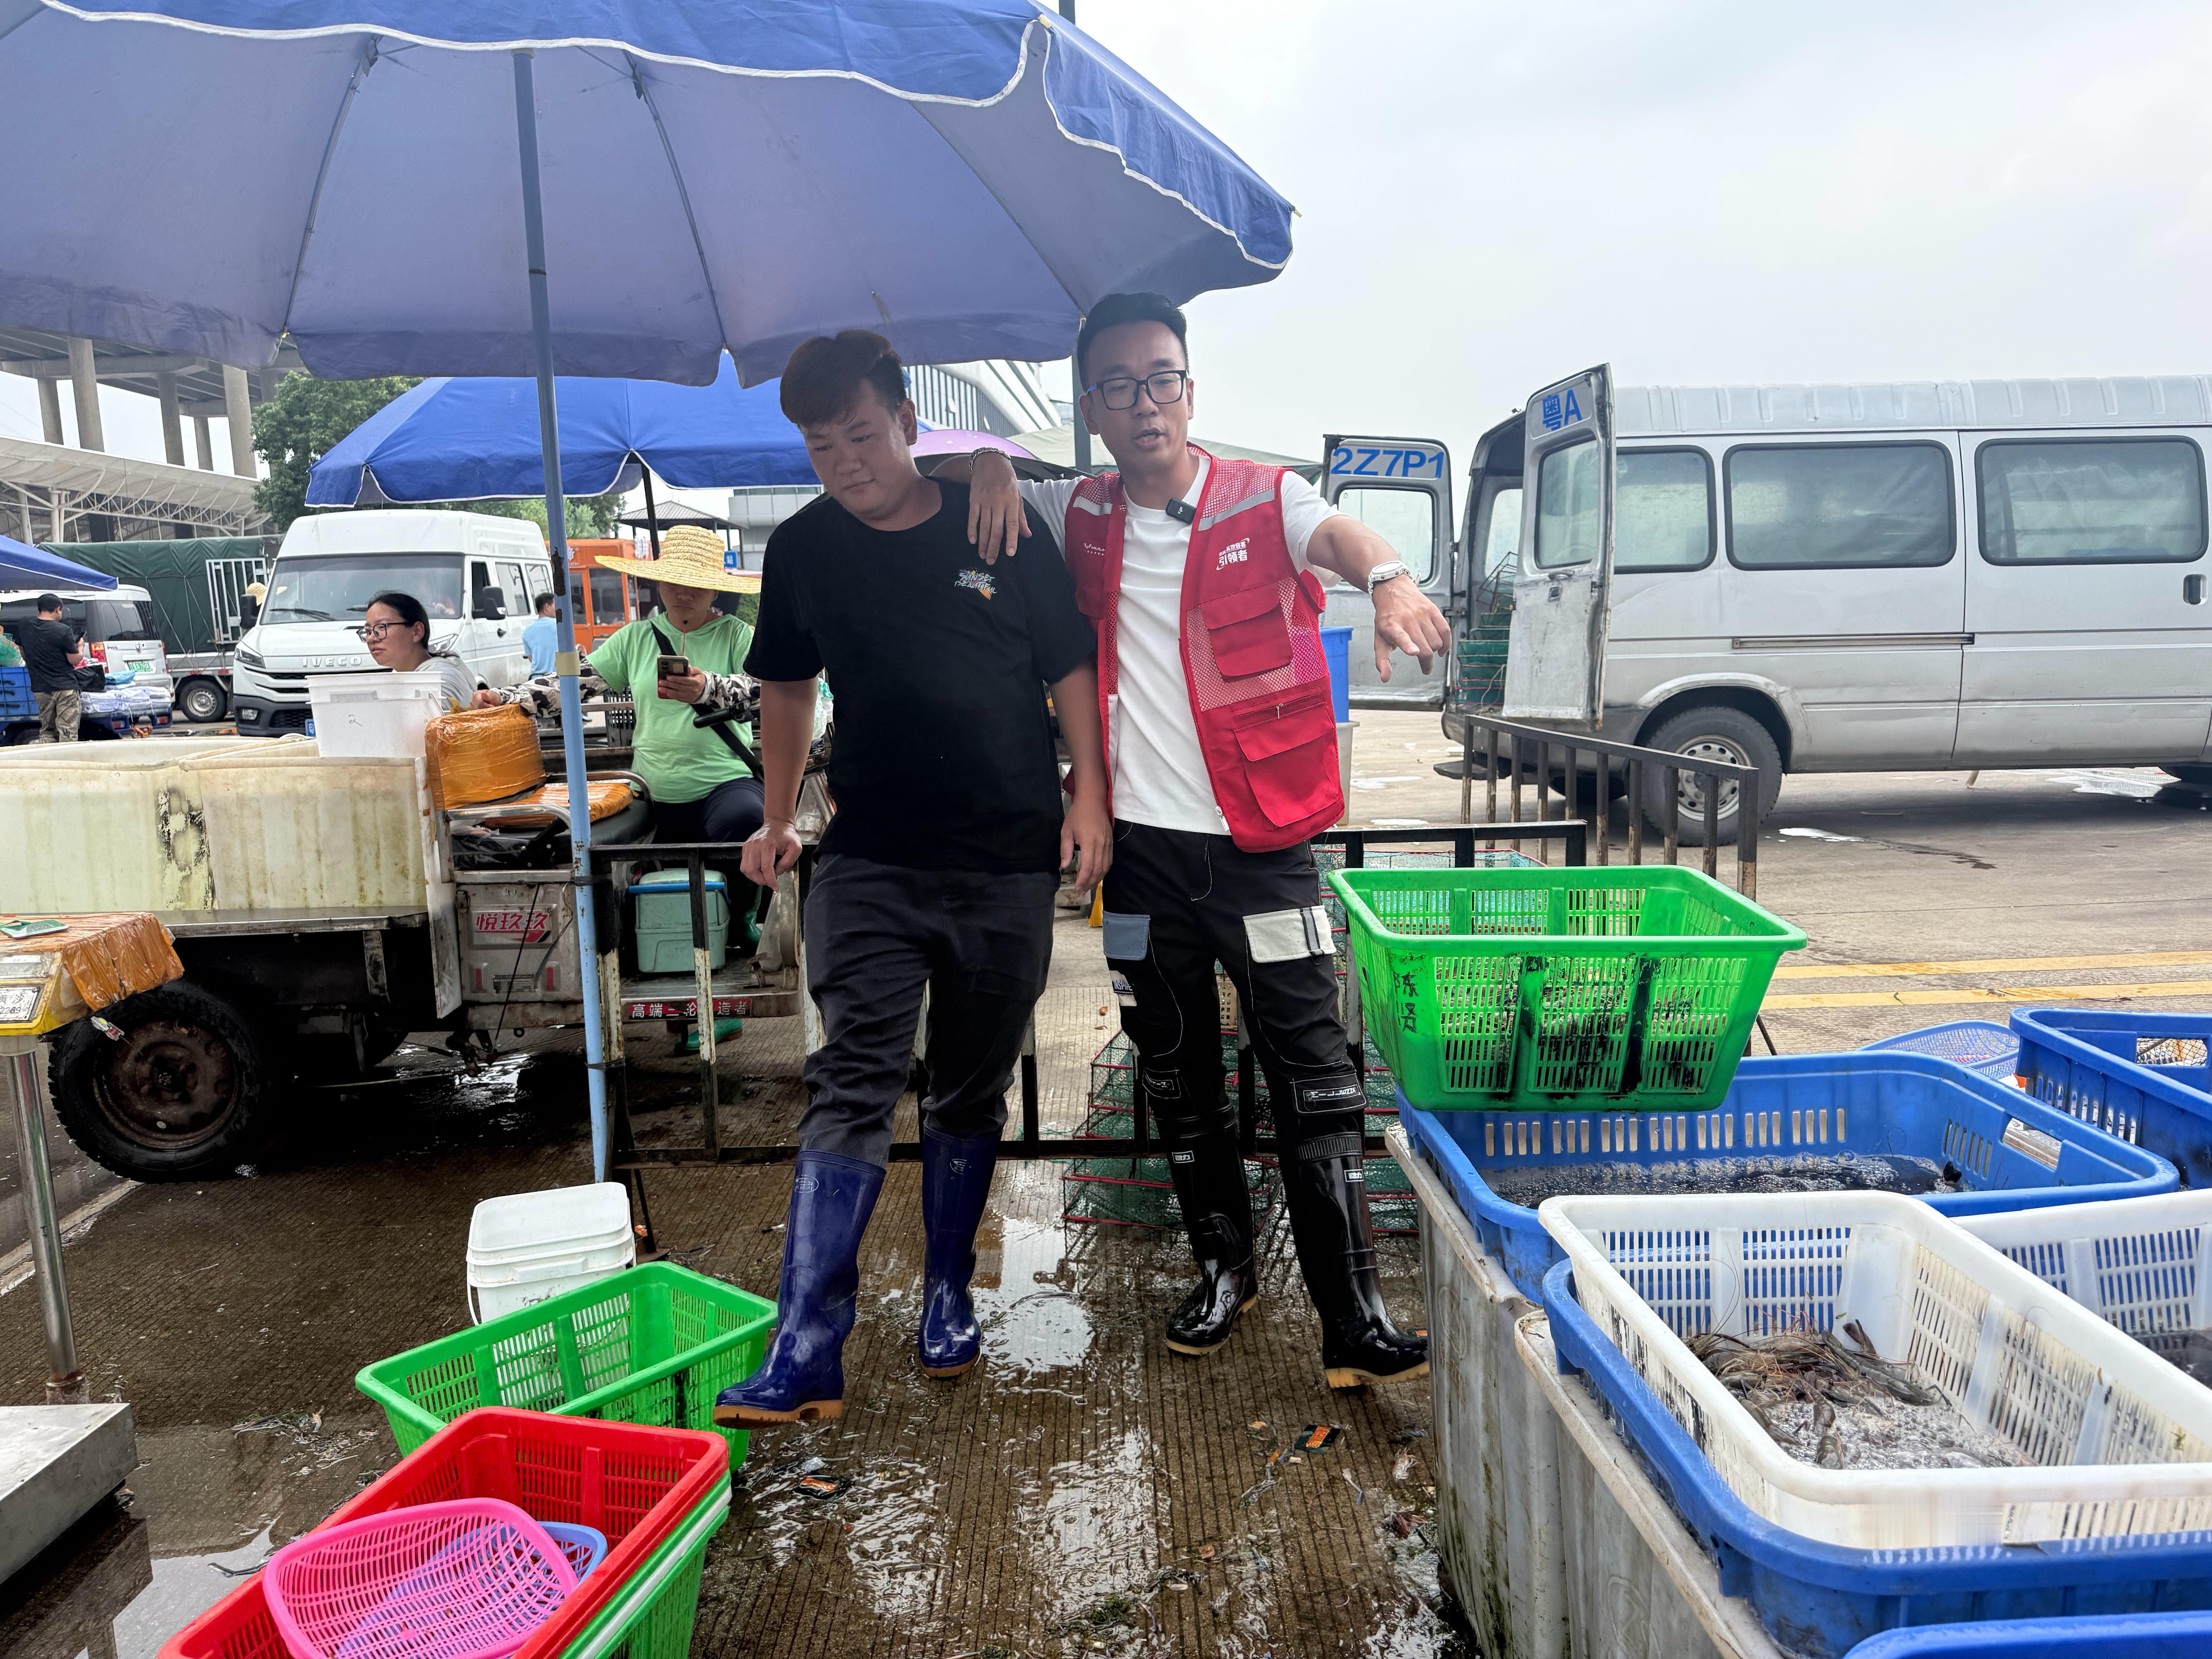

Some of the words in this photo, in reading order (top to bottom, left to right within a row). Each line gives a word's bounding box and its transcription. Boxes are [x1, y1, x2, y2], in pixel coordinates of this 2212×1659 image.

[1542, 388, 1583, 431] 粤A
[1330, 448, 1444, 479] 2Z7P1
[1219, 549, 1248, 567] 引领者
[302, 656, 362, 667] IVECO
[476, 912, 549, 931] 悦玖玖
